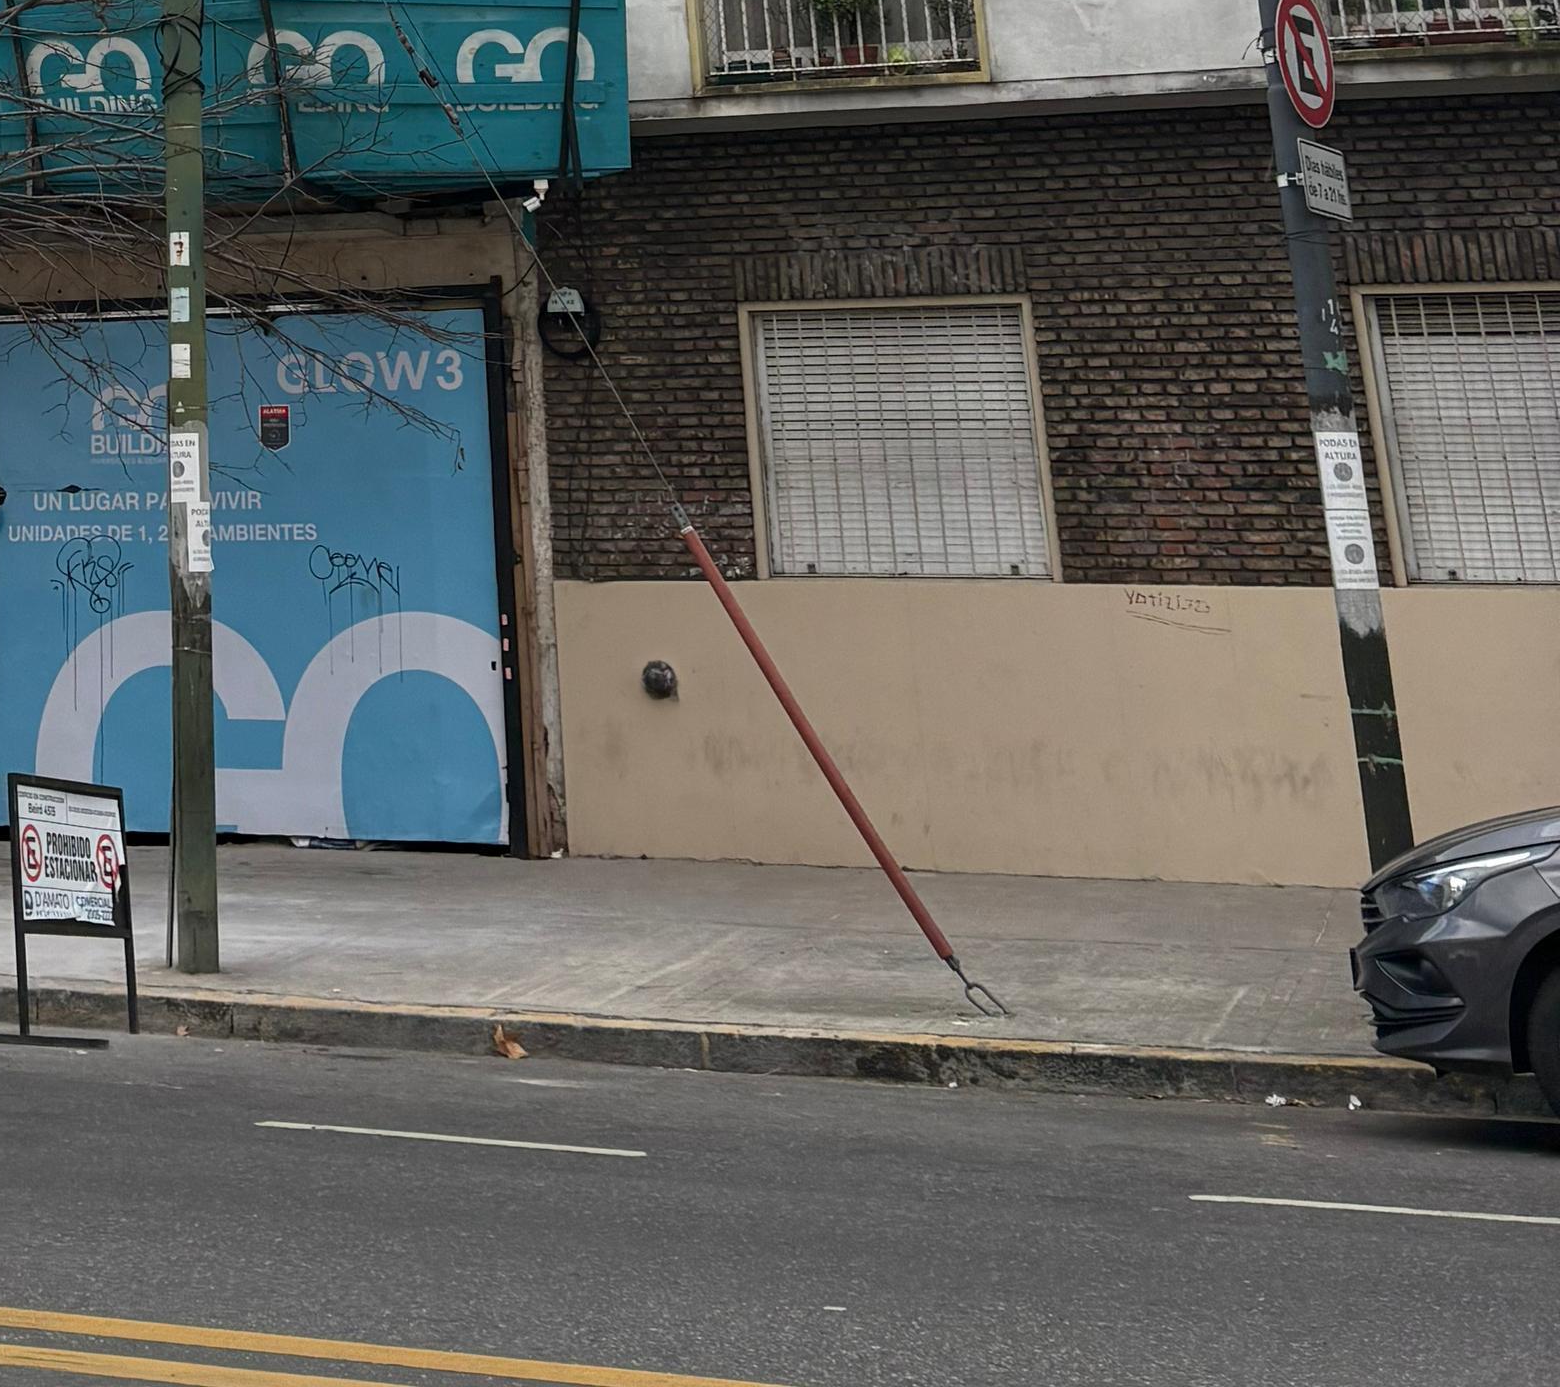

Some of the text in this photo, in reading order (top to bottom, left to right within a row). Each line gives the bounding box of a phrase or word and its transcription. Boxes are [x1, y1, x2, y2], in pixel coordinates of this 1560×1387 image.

[25, 37, 152, 94] GO
[247, 30, 385, 85] GO
[456, 27, 595, 83] GO
[1319, 438, 1347, 449] PODAS
[1324, 448, 1358, 461] ALTURA
[33, 492, 65, 512] UN
[69, 492, 140, 511] LUGAR
[9, 525, 115, 543] UNIDADES
[118, 525, 134, 542] DE
[209, 523, 318, 541] AMBIENTES
[46, 831, 91, 860] PROHIBIDO
[44, 855, 98, 883] ESTACIONAR
